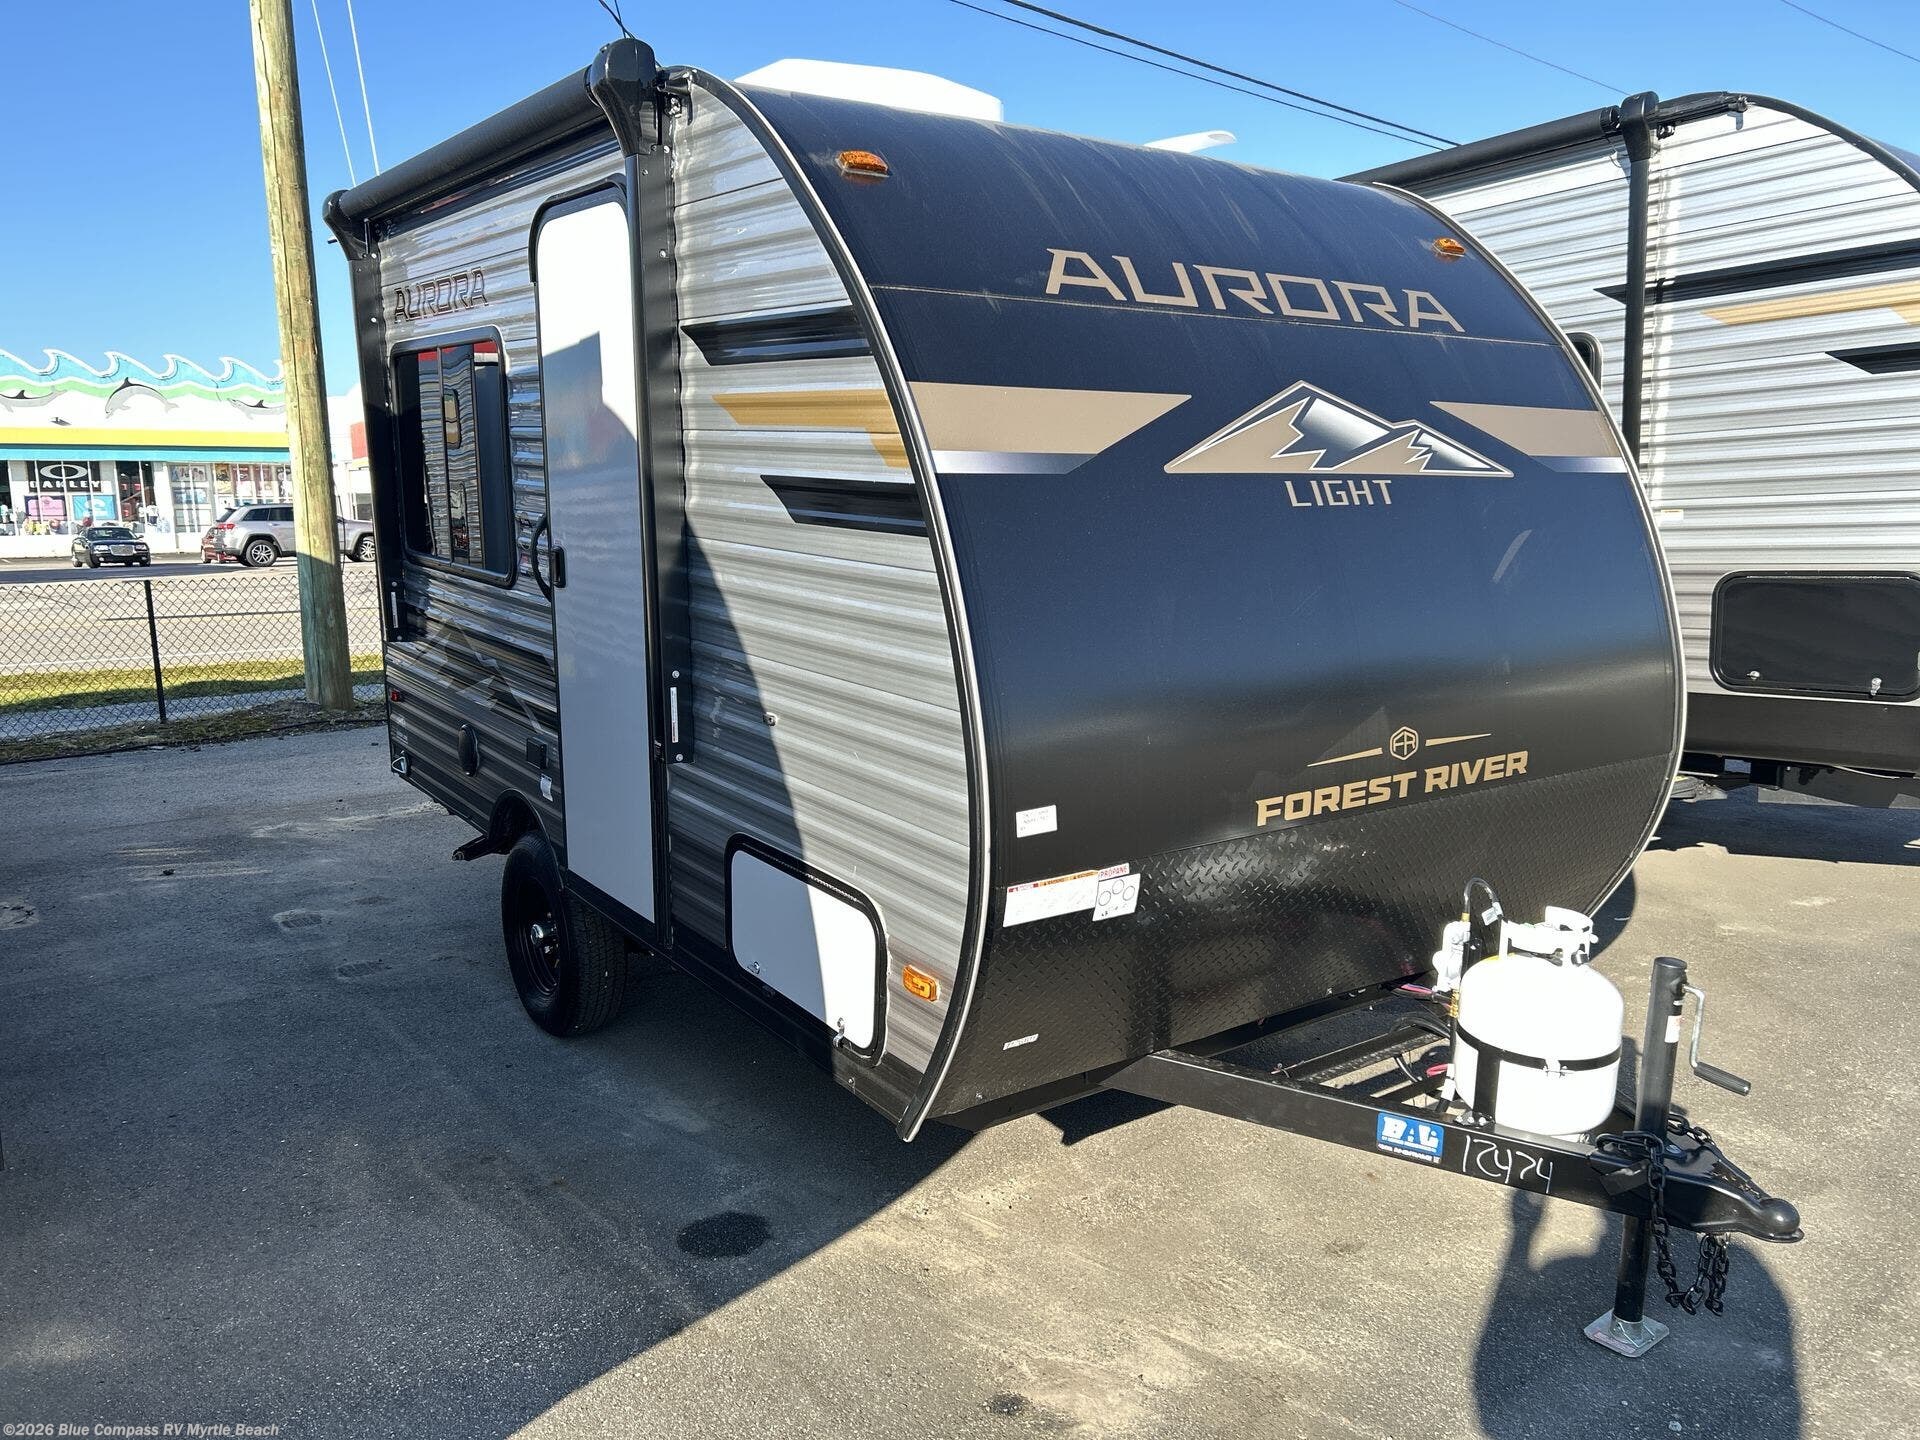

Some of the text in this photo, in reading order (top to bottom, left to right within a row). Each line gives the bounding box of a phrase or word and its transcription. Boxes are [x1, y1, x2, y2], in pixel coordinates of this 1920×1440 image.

[394, 267, 489, 323] AURORA
[1046, 248, 1465, 332] AURORA
[29, 480, 102, 490] OAKLEY
[1284, 480, 1392, 507] LIGHT
[1255, 750, 1529, 827] FOREST RIVER
[1099, 865, 1128, 879] PROPANE
